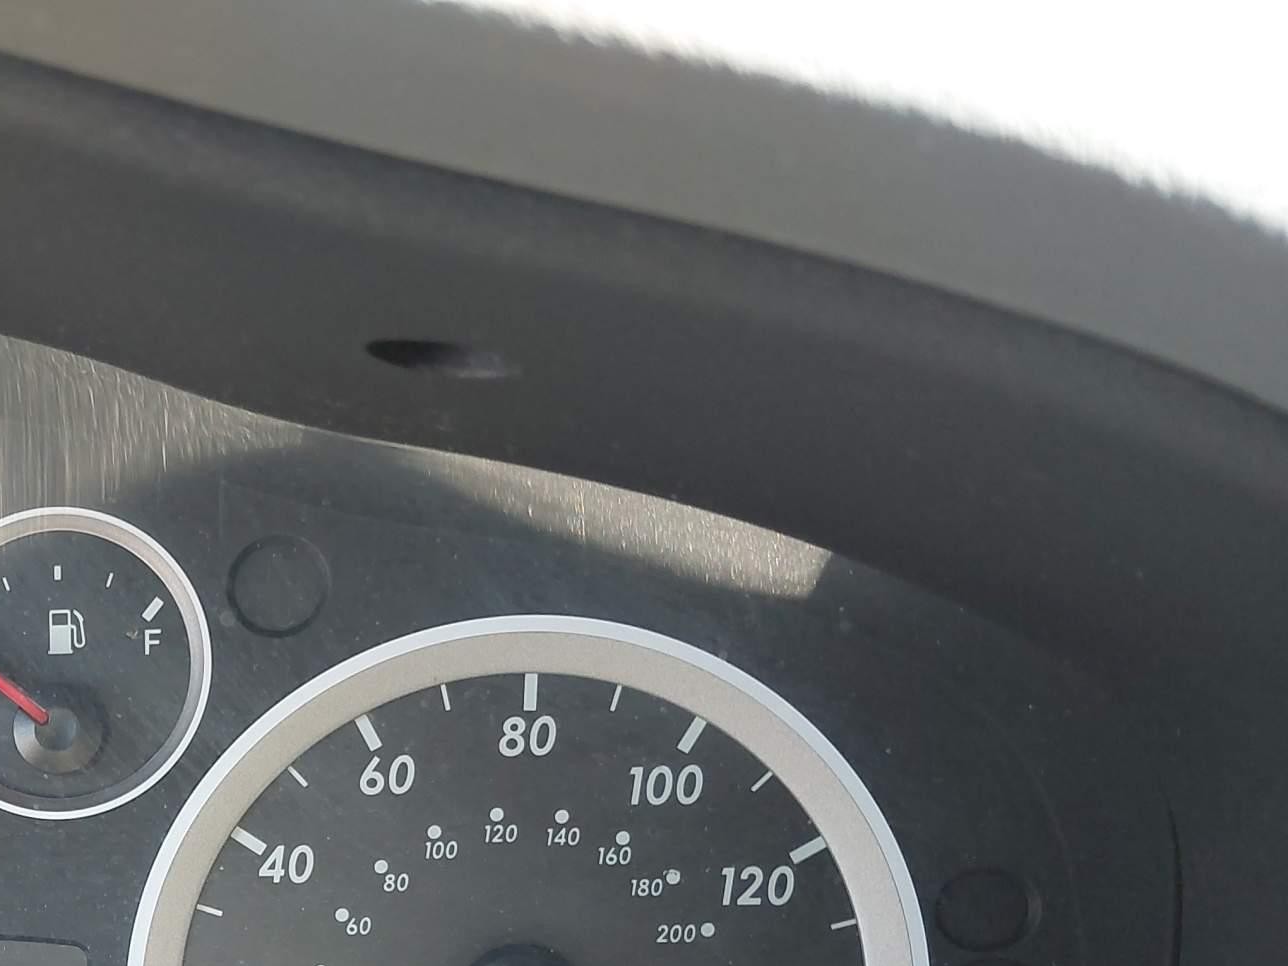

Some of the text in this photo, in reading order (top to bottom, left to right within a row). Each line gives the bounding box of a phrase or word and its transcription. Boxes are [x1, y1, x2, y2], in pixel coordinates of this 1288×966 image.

[144, 628, 162, 656] F
[498, 715, 557, 757] 80
[359, 754, 415, 796] 60
[629, 764, 704, 806] 100
[484, 824, 518, 843] 120
[547, 827, 580, 847] 140
[425, 840, 458, 860] 100
[598, 846, 632, 866] 160
[258, 843, 314, 884] 40
[383, 873, 409, 892] 80
[631, 878, 663, 897] 180
[721, 865, 795, 906] 120
[346, 913, 372, 935] 60
[656, 924, 696, 943] 200
